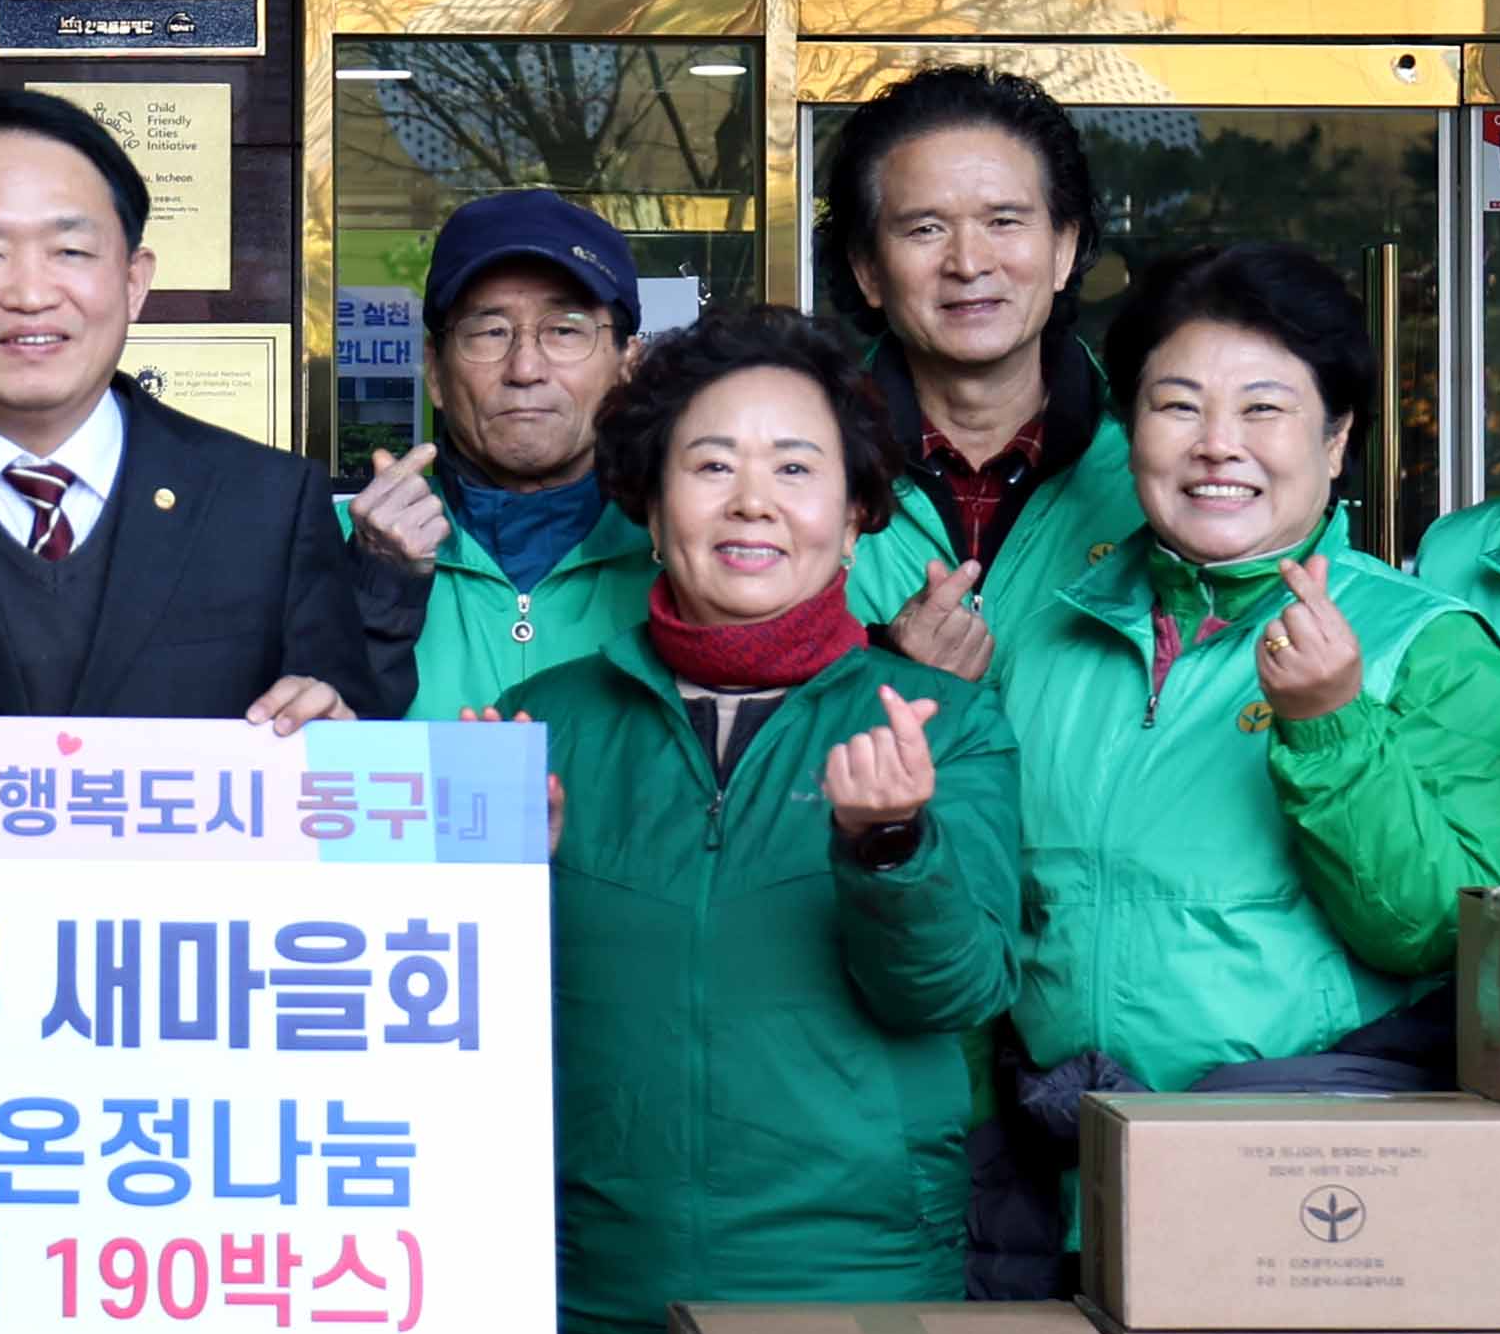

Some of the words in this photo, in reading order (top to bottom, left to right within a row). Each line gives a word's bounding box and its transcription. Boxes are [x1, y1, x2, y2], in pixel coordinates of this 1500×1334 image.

[147, 102, 177, 114] Child
[147, 115, 192, 129] Friendly
[147, 127, 179, 139] Cities
[147, 140, 199, 152] Initiative
[155, 173, 193, 183] Incheon
[362, 300, 411, 328] 실천
[40, 917, 482, 1053] 새마을회
[44, 1229, 425, 1334] 190박스)
